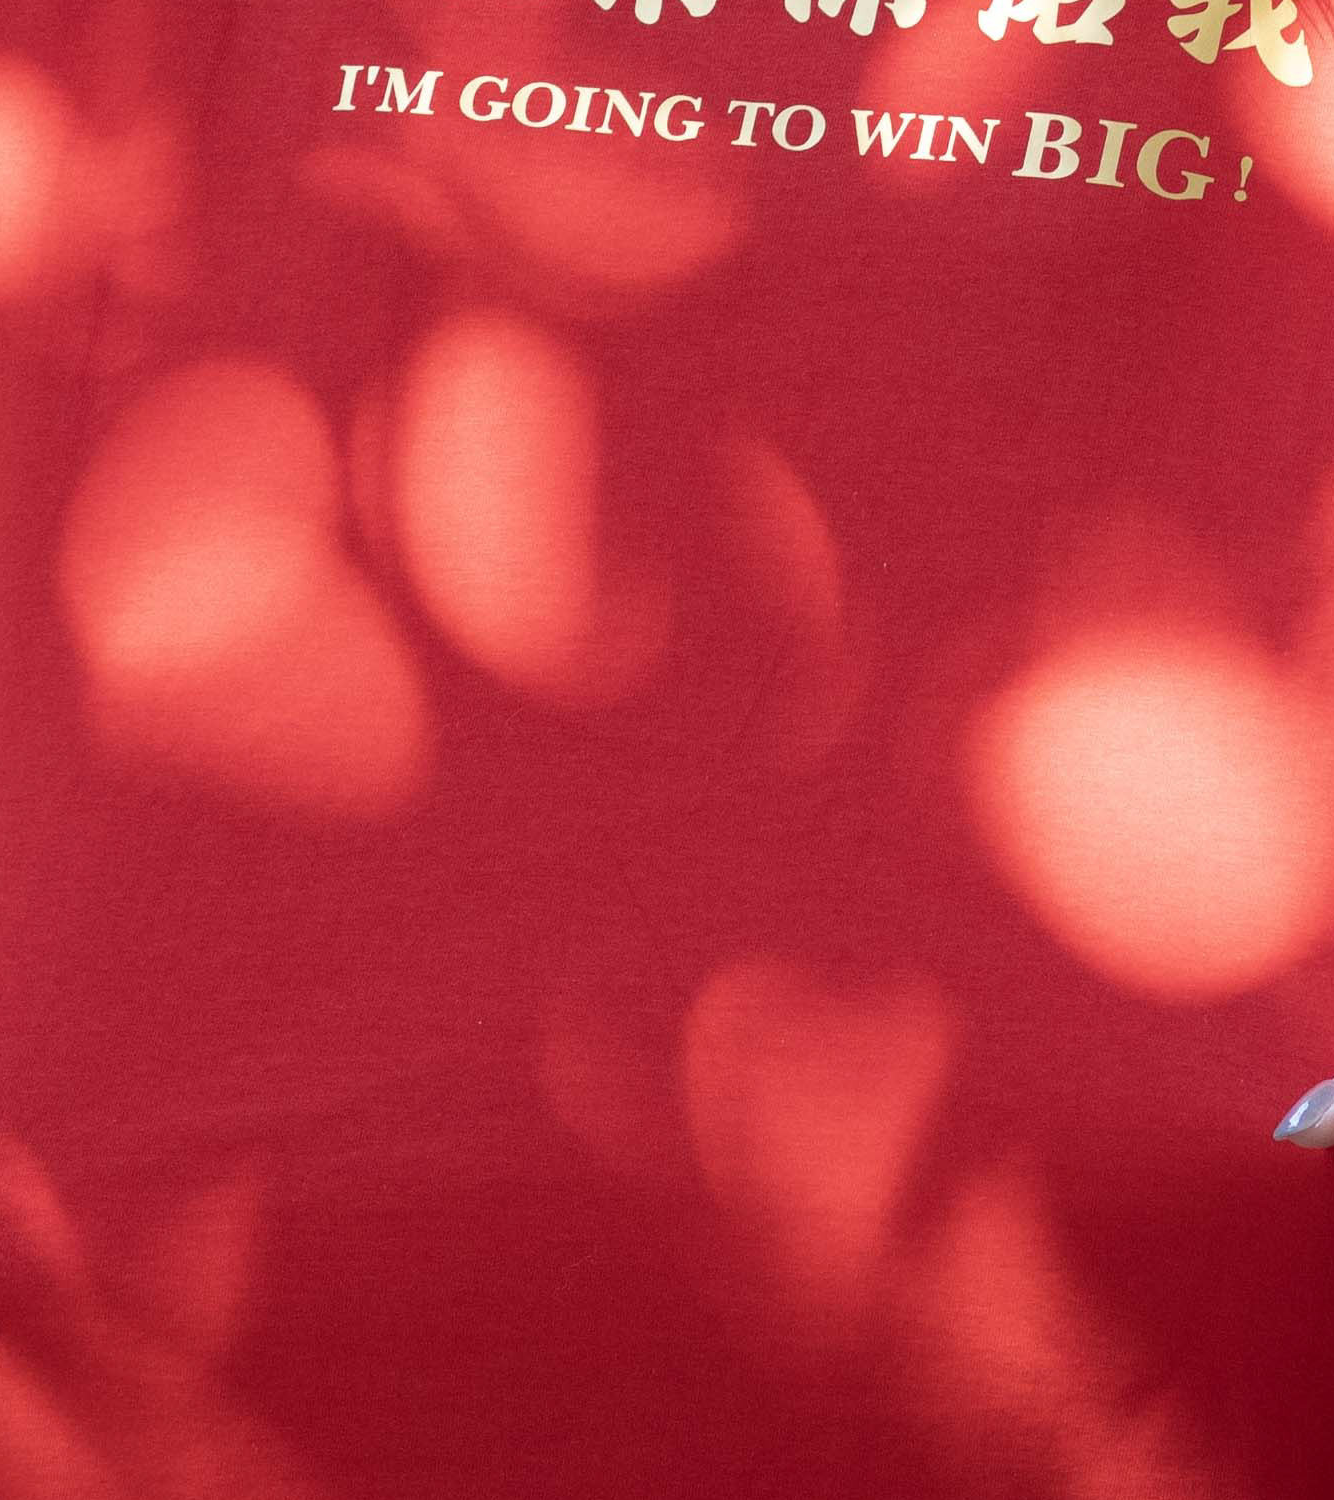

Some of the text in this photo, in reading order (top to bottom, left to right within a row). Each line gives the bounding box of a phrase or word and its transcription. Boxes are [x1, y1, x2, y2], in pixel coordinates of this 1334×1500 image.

[332, 65, 444, 116] I'M
[459, 76, 705, 143] GOING
[727, 100, 826, 153] TO
[851, 108, 1001, 166] WIN
